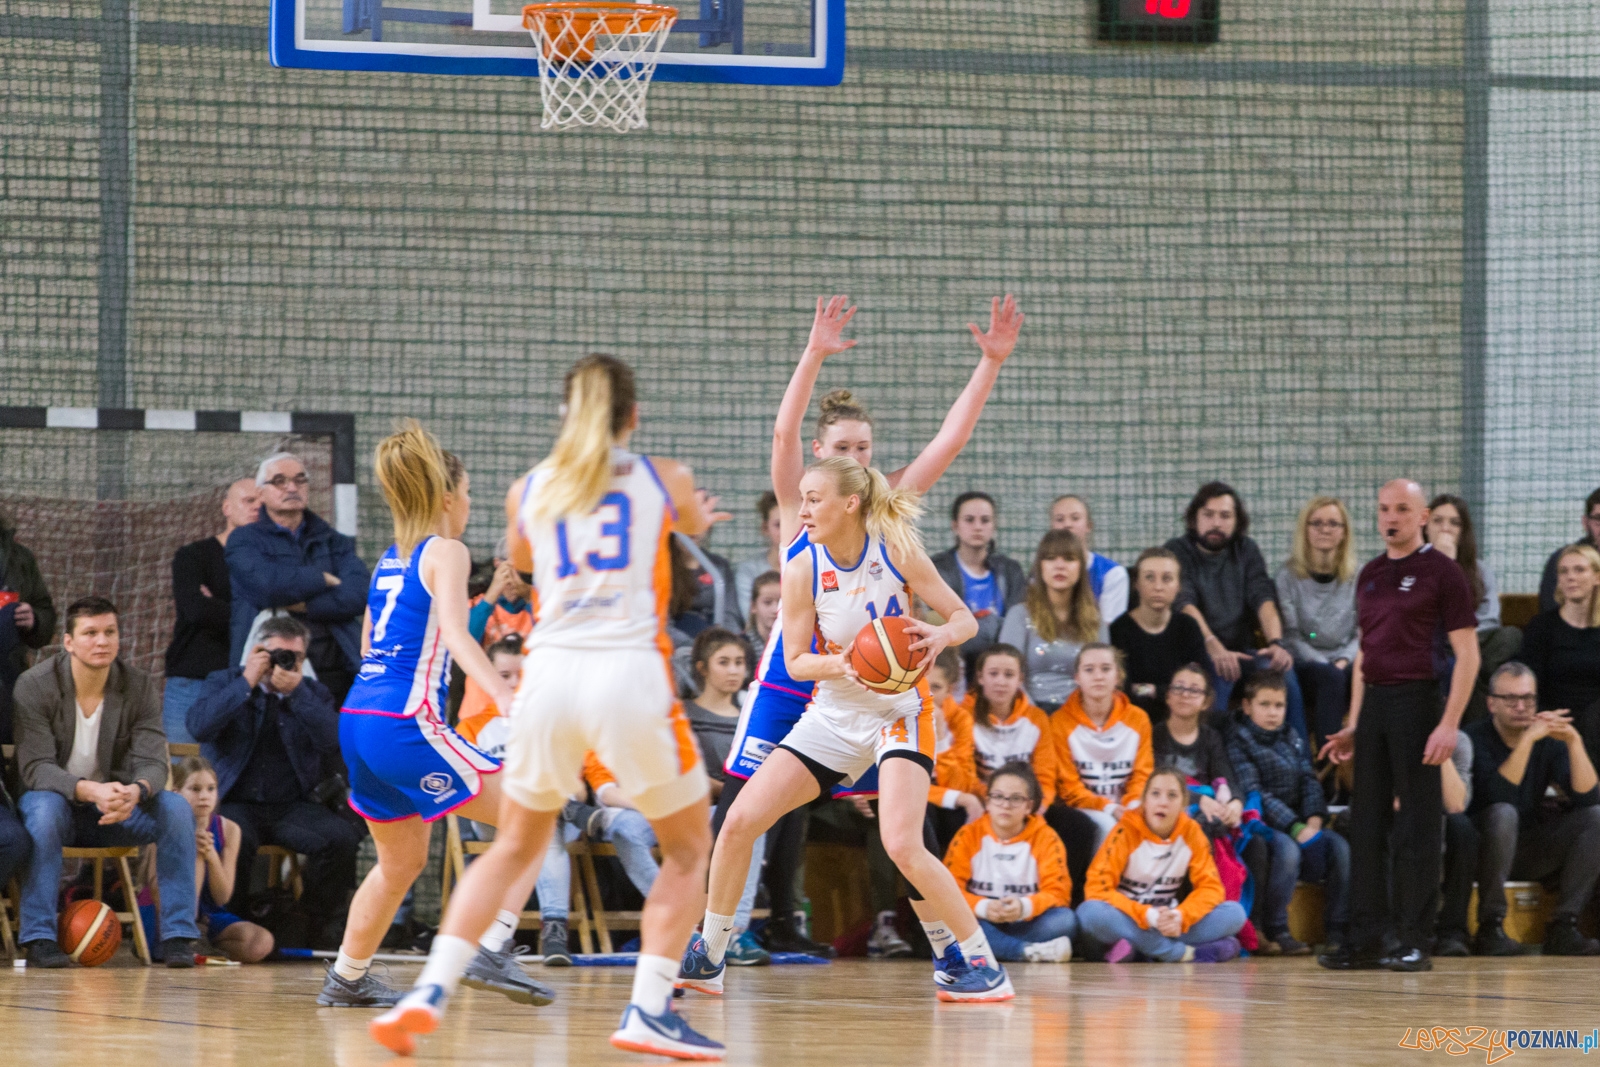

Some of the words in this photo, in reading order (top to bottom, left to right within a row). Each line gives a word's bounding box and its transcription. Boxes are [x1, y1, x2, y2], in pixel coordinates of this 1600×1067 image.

[556, 490, 631, 580] 13
[375, 574, 405, 642] 7
[865, 594, 904, 621] 14
